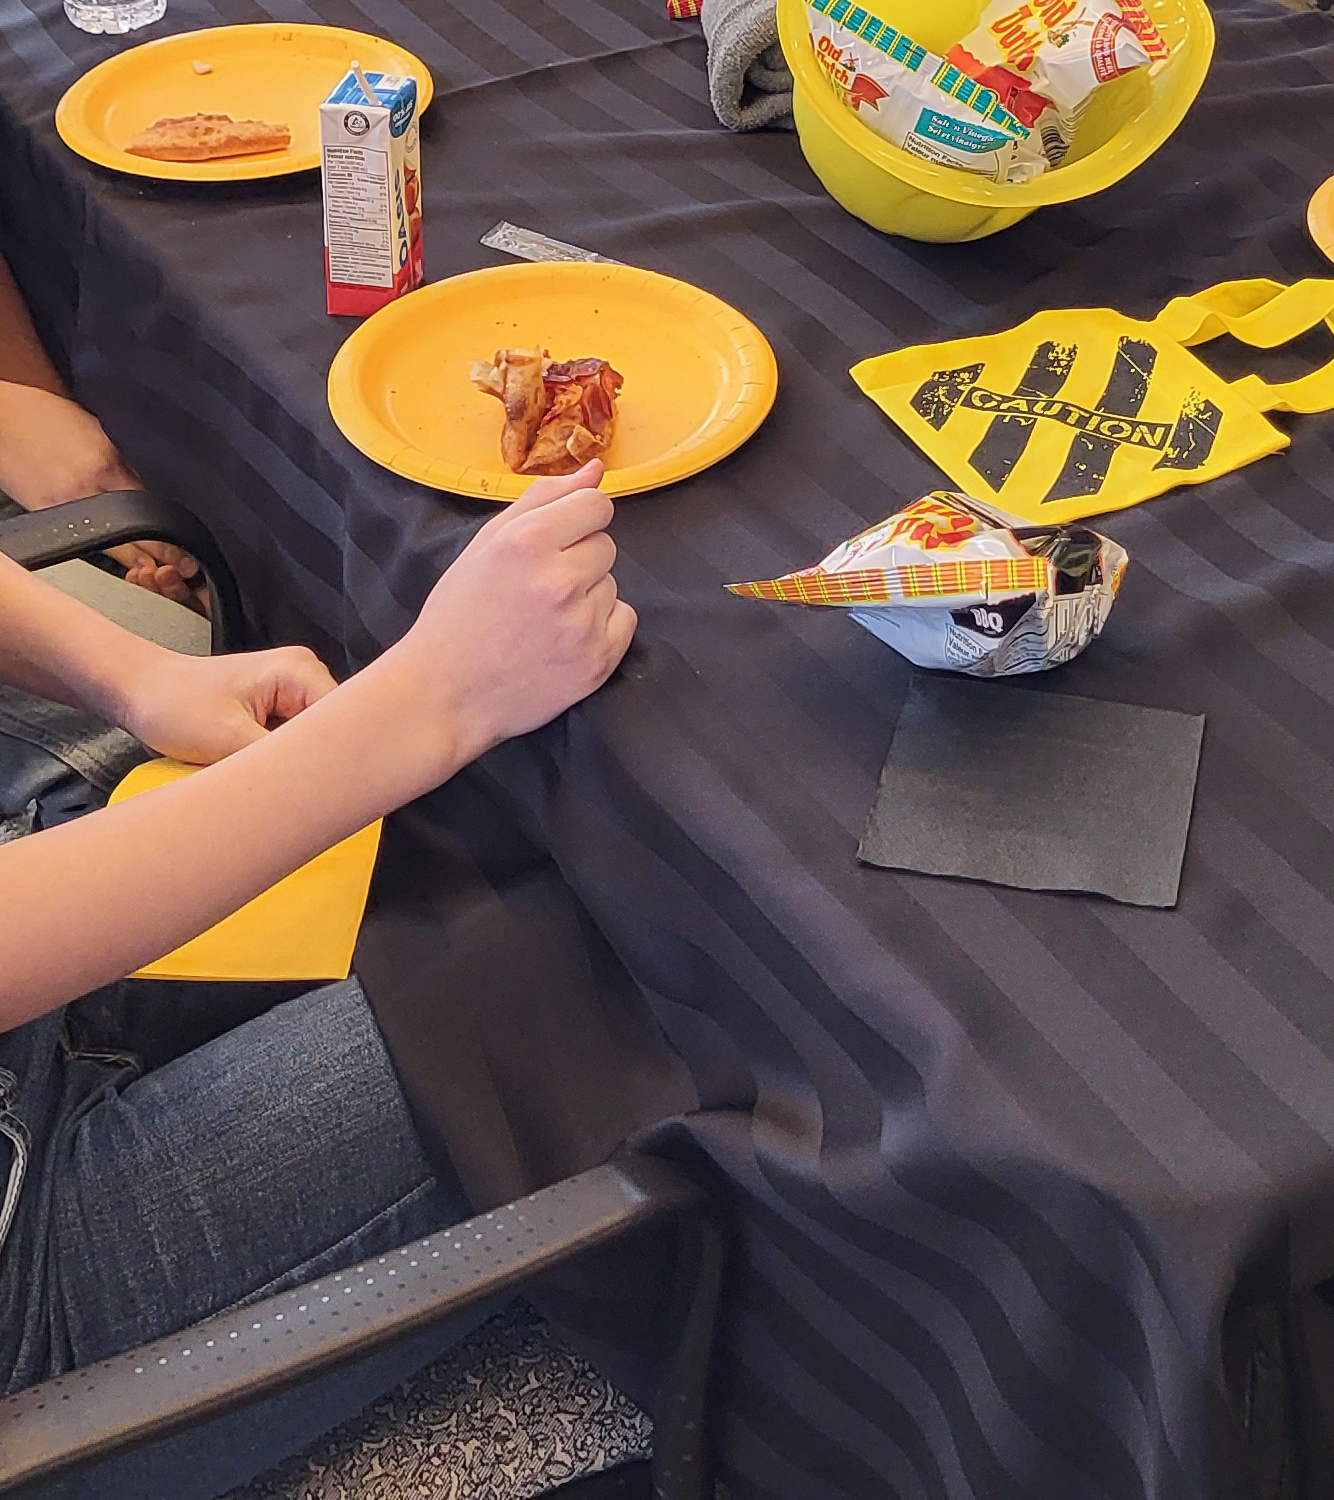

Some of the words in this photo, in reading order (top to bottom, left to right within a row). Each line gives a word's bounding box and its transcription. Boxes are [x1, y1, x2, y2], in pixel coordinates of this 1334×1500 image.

[818, 35, 843, 62] Old
[991, 4, 1044, 71] Duth
[927, 125, 941, 136] Sel
[931, 115, 950, 128] Salt
[962, 126, 994, 142] Vinega
[908, 135, 940, 157] Nutrition
[971, 390, 1166, 447] CAUTION
[970, 608, 1004, 633] BBQ
[949, 627, 978, 654] Nutrition
